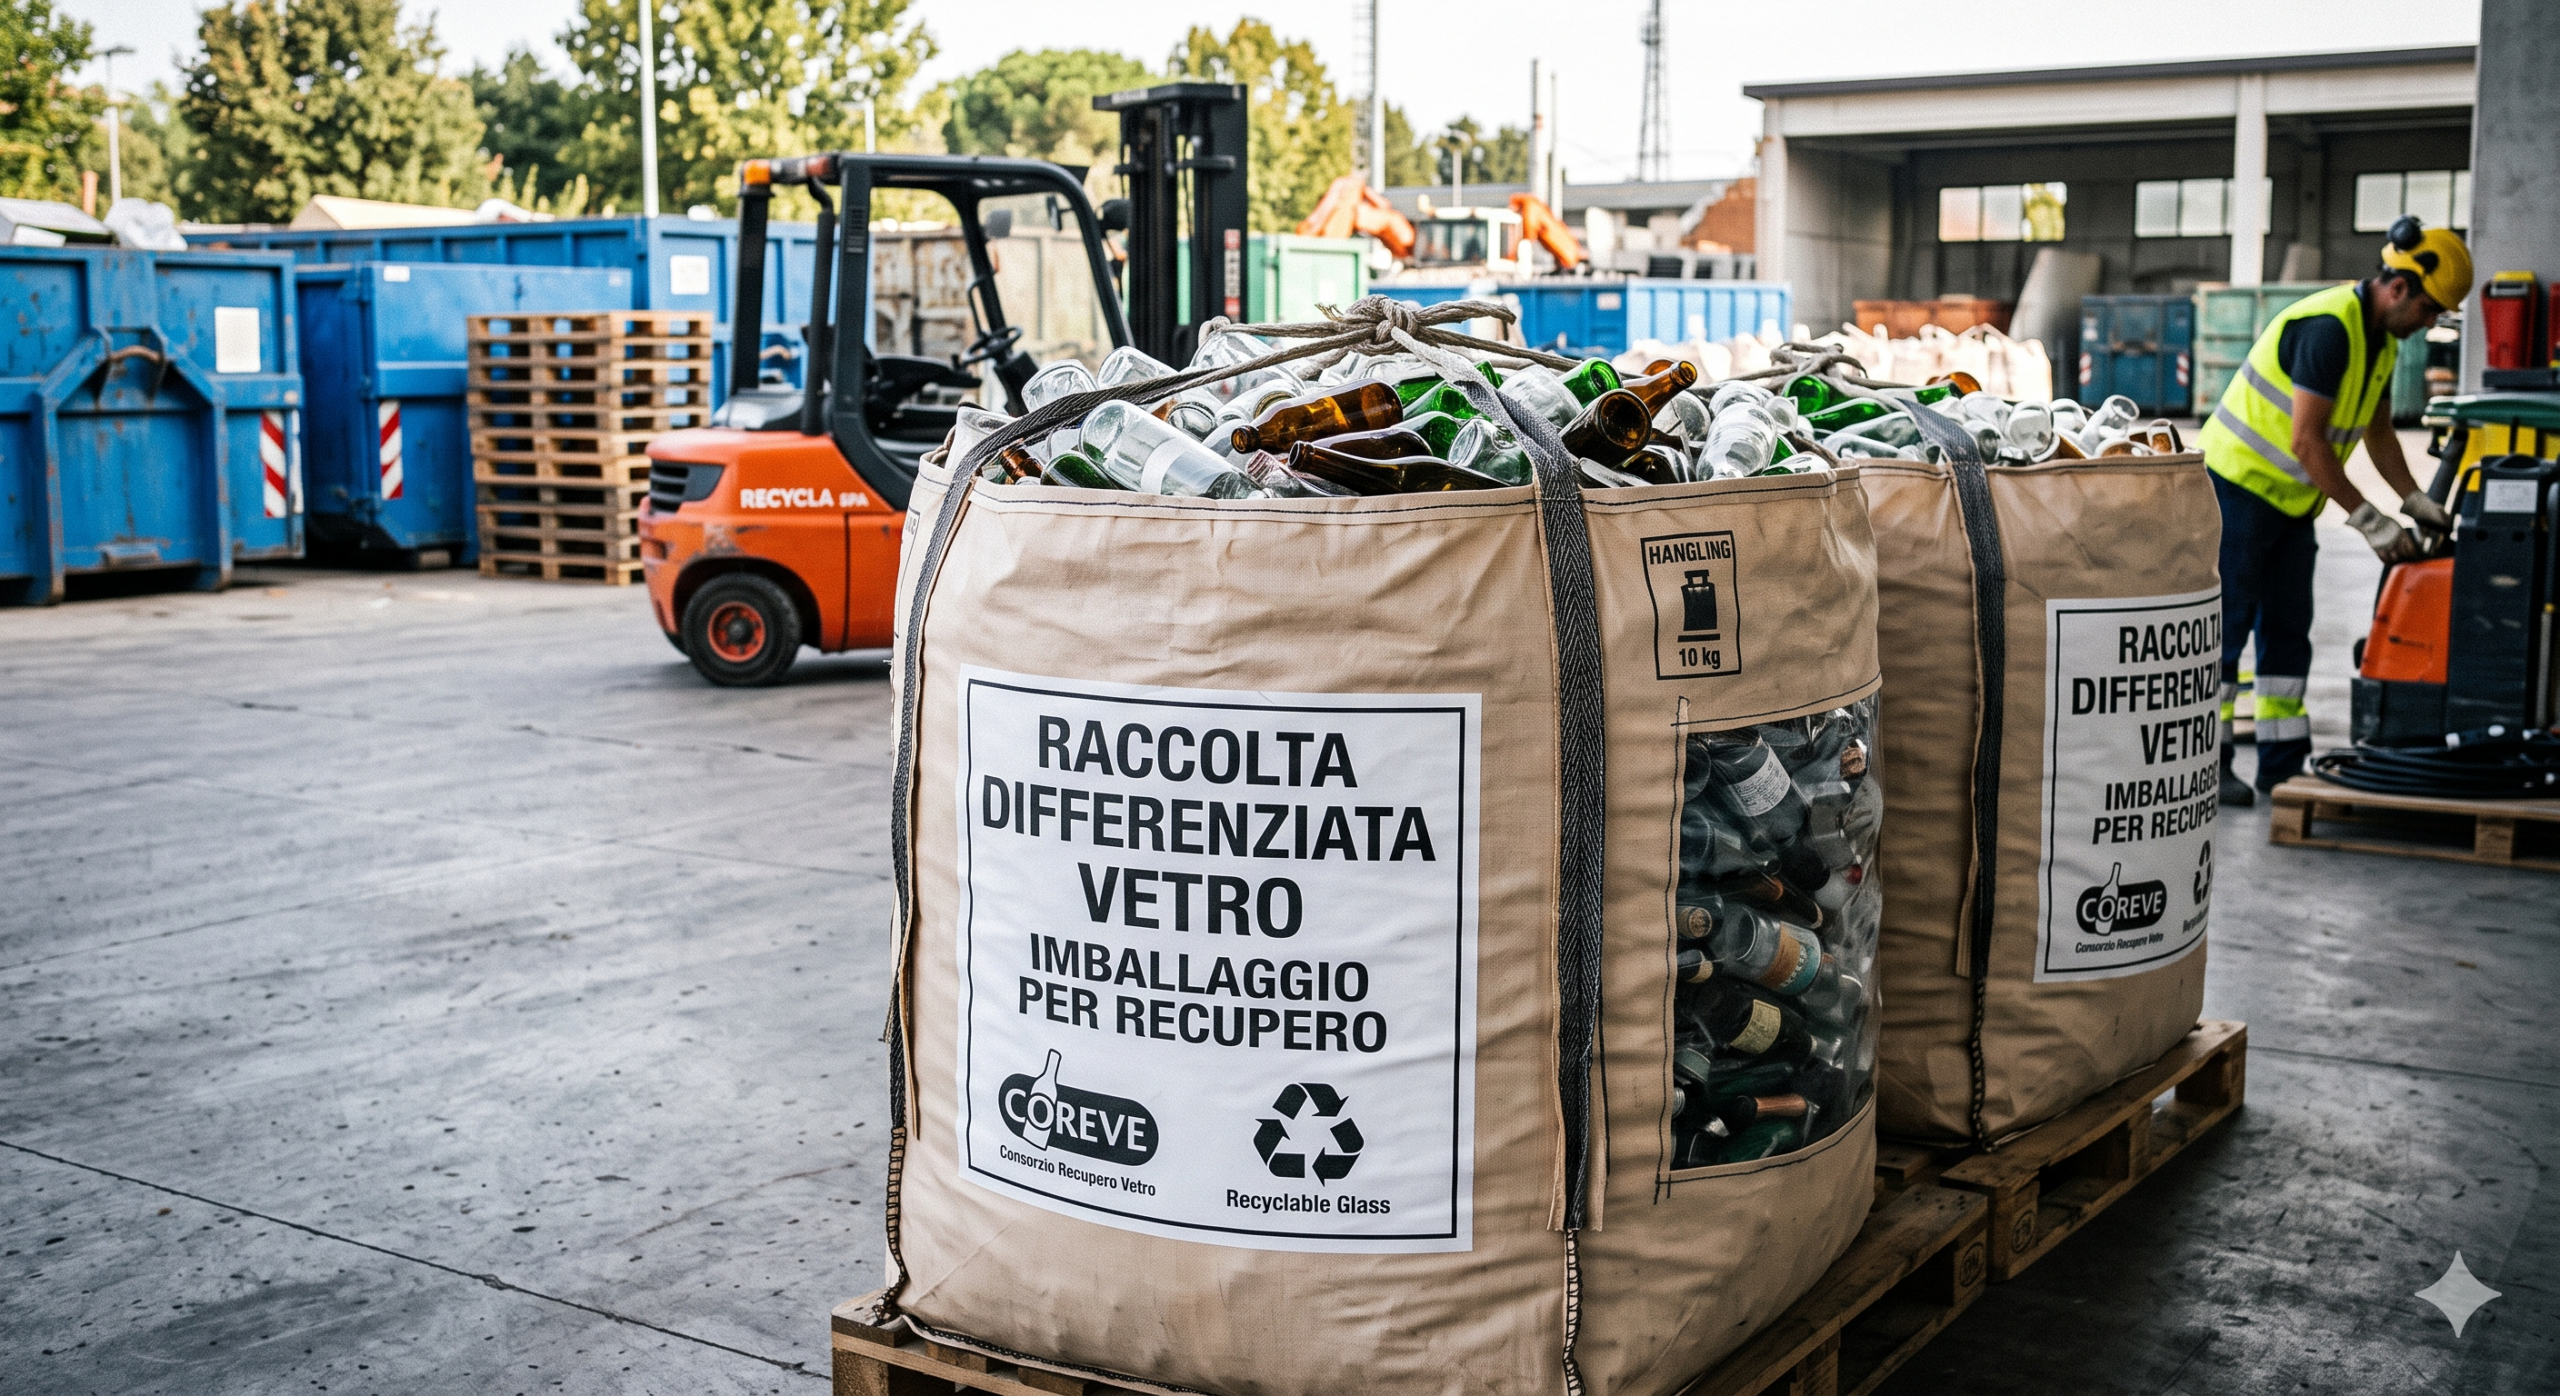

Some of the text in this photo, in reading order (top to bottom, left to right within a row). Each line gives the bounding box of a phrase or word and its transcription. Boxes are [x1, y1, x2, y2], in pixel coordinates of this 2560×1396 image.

[740, 488, 835, 508] RECYCLA
[1649, 540, 1731, 565] HANGLING
[1679, 647, 1721, 669] 10 kg
[1039, 715, 1357, 788] RACCOLTA
[2140, 710, 2215, 765] VETRO
[982, 775, 1436, 862] DIFFERENZIATA
[2092, 814, 2144, 845] PER
[1078, 862, 1302, 939] VETRO
[2081, 890, 2163, 922] COREVE
[1030, 932, 1369, 1002] IMBALLAGGIO
[1019, 976, 1387, 1053] PER RECUPERO
[1004, 1088, 1147, 1152] COREVE
[1000, 1145, 1156, 1197] Consorzio Recupero Vetro
[1226, 1188, 1391, 1214] Recyclable Glass
